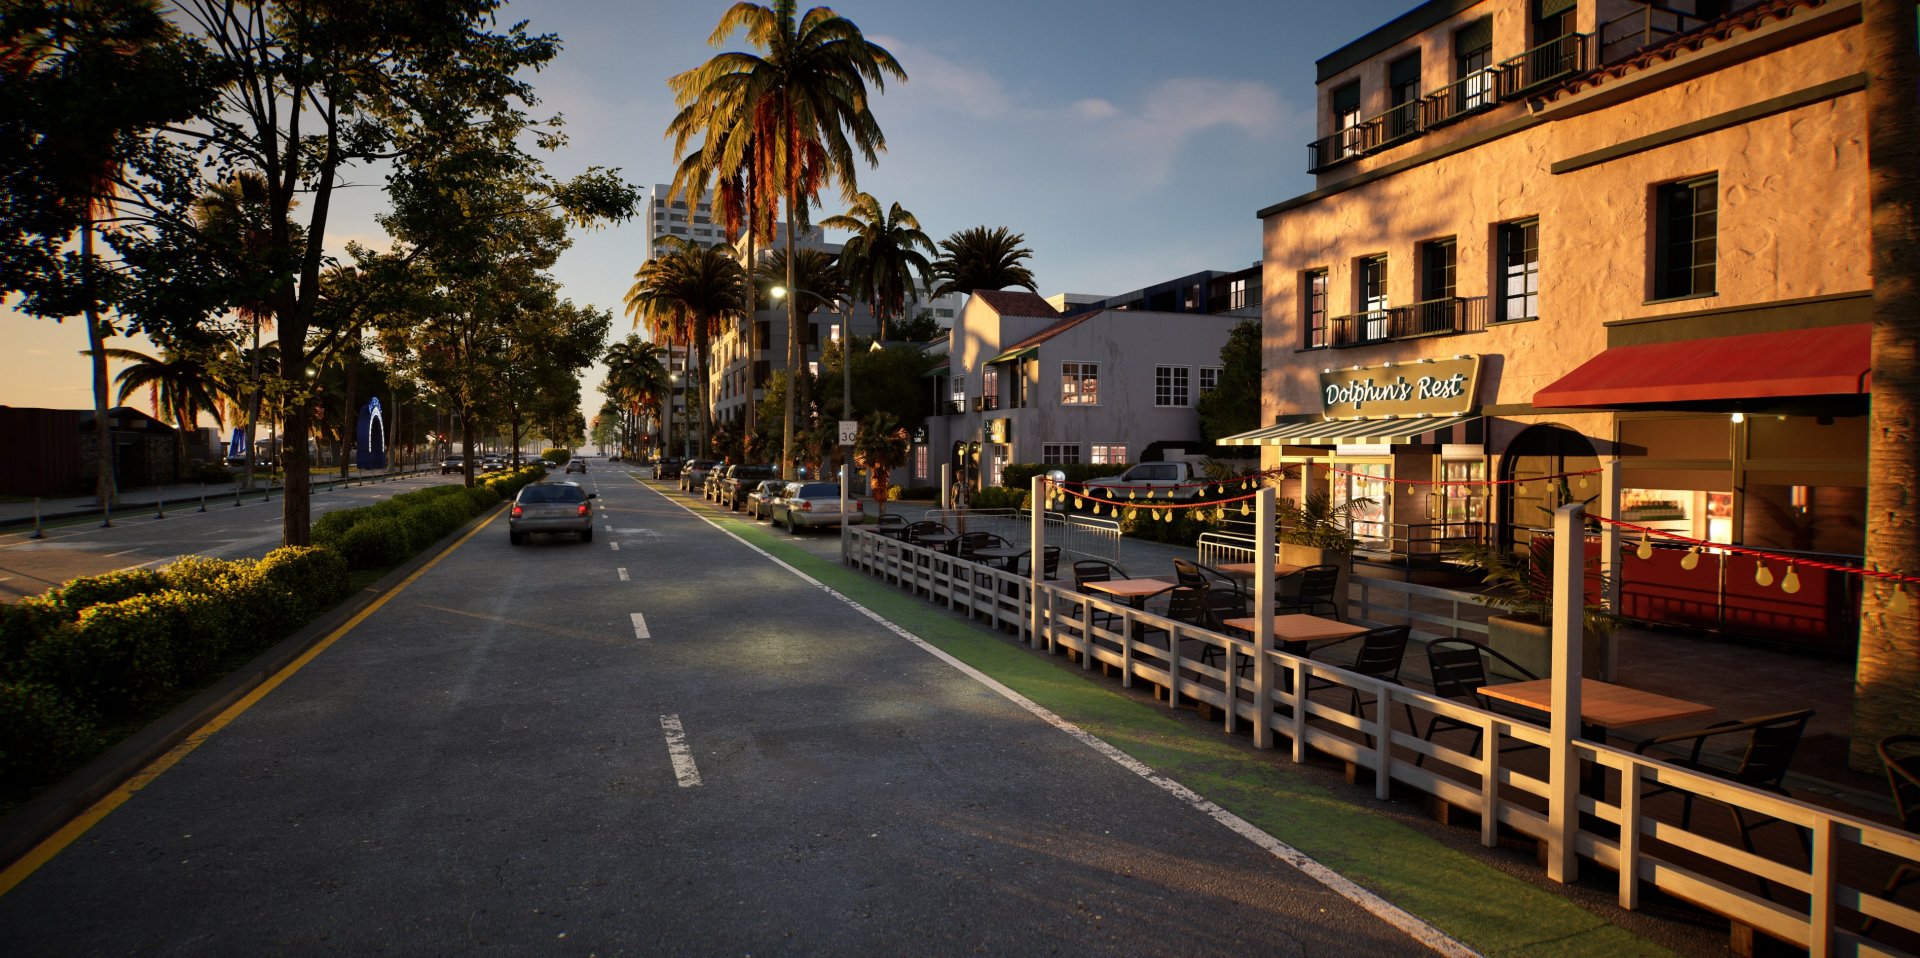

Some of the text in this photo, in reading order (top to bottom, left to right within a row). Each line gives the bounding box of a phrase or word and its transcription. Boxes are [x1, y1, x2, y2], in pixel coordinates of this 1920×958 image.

[1326, 373, 1465, 410] Dolphin's Rest
[841, 432, 856, 442] 30
